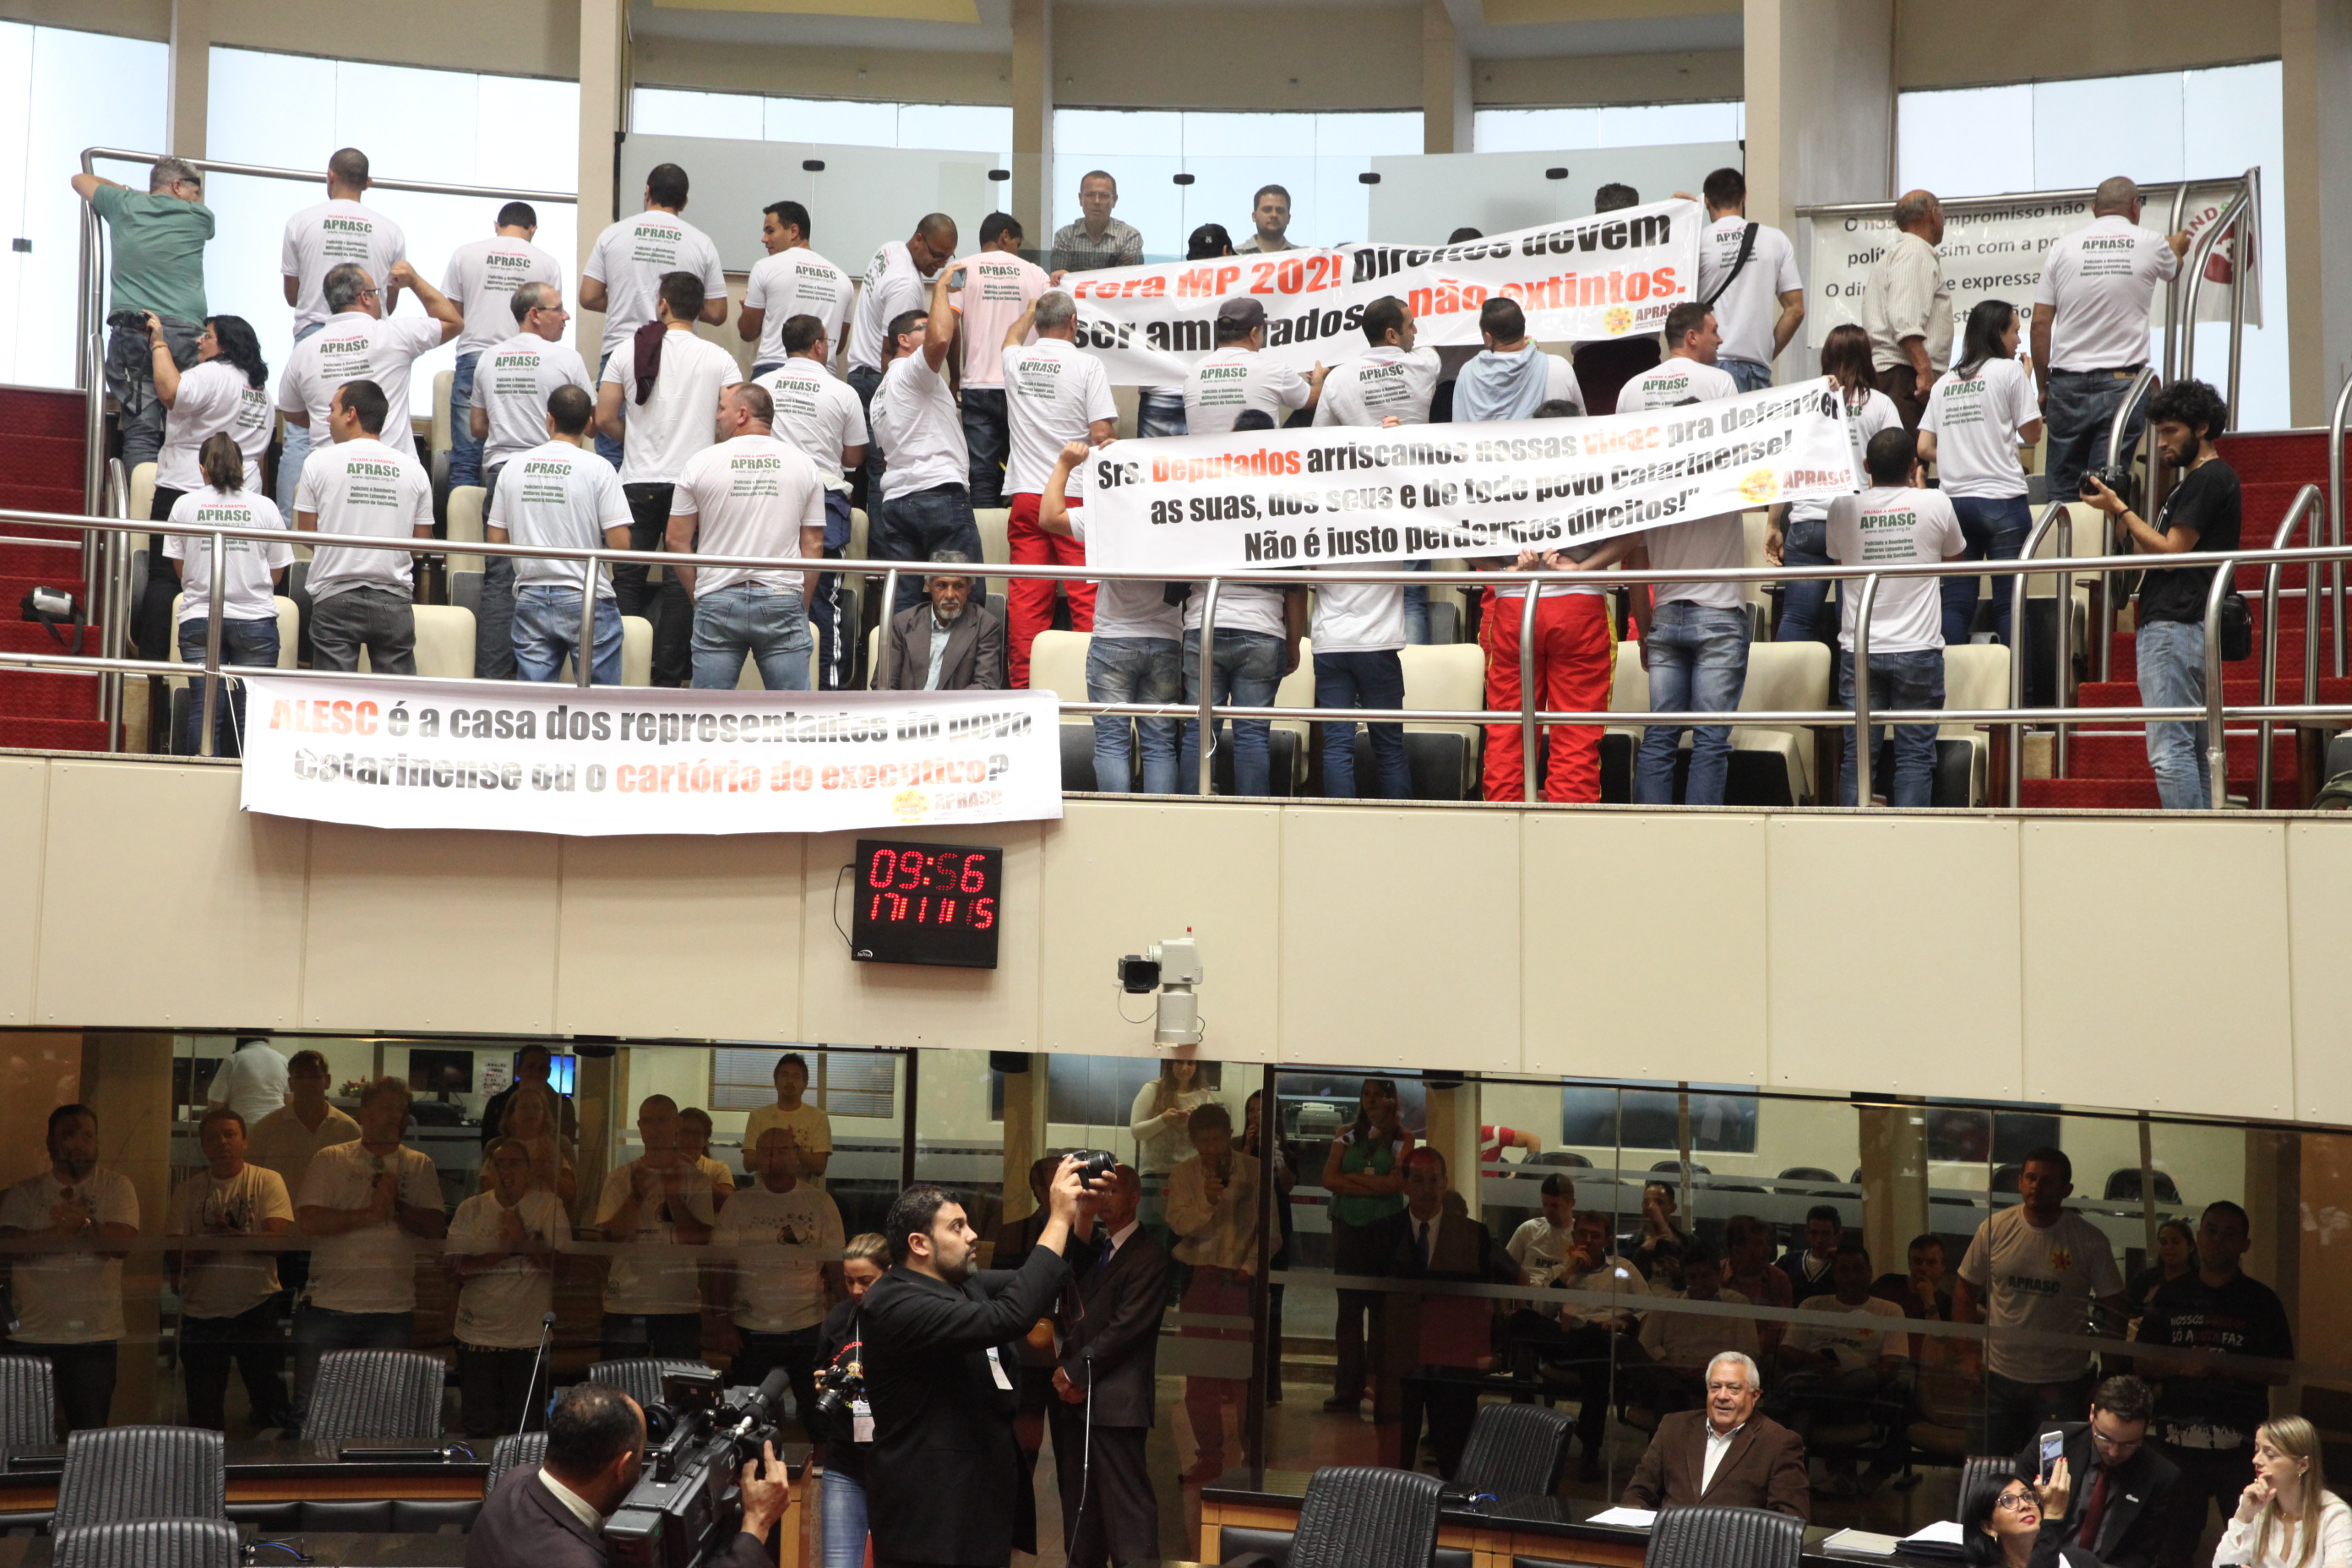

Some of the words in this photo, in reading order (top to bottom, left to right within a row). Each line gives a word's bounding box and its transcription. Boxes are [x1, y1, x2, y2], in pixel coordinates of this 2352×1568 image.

[1864, 219, 1896, 231] nos
[1943, 205, 2045, 227] mpromisso
[2050, 201, 2085, 216] não
[323, 219, 373, 233] APRASC
[634, 227, 682, 241] APRASC
[1977, 237, 2014, 255] com
[2021, 238, 2031, 250] a
[2082, 238, 2135, 250] APRASC
[486, 255, 531, 268] APRASC
[1074, 275, 1167, 299] Fora
[1177, 265, 1241, 297] MP
[1250, 254, 1343, 295] 202!
[1352, 241, 1512, 284] Direitos
[1522, 214, 1672, 256] devem
[795, 265, 837, 280] APRASC
[979, 265, 1021, 276] APRASC
[1825, 283, 1839, 297] O
[1845, 282, 1865, 296] dir
[1075, 320, 1136, 350] ser
[1146, 304, 1364, 351] amados
[1407, 279, 1488, 318] não
[1499, 266, 1686, 311] extintos.
[1636, 302, 1684, 321] APRAS
[319, 339, 369, 353] APRASC
[494, 356, 540, 368] APRASC
[1019, 361, 1061, 373] APRASC
[1200, 367, 1247, 379] APRASC
[1359, 364, 1404, 381] APRASC
[775, 379, 820, 393] APRASC
[1642, 377, 1689, 391] APRASC
[1942, 380, 1985, 397] APRASC
[1098, 460, 1146, 489] Srs.
[1152, 449, 1301, 483] Deputados
[1307, 441, 1468, 472] arriscamos
[1475, 435, 1576, 462] nossas
[1668, 417, 1713, 448] pra
[1721, 389, 1839, 433] defender
[346, 463, 400, 477] APRASC
[523, 462, 572, 476] APRASC
[730, 458, 781, 469] APRASC
[1151, 498, 1183, 524] as
[1190, 494, 1261, 521] suas,
[1268, 490, 1319, 515] dos
[1326, 487, 1393, 512] seus
[1400, 483, 1416, 508] e
[1423, 478, 1457, 507] de
[1464, 475, 1528, 504] todo
[1536, 470, 1603, 502] povo
[1610, 429, 1793, 487] Catarinense!
[1783, 469, 1851, 489] APRASC
[197, 509, 252, 521] APRASC
[1859, 512, 1916, 530] APRASC
[1244, 530, 1296, 562] Não
[1304, 527, 1320, 558] é
[1326, 524, 1398, 559] justo
[1405, 514, 1562, 554] perdermos
[270, 700, 378, 736] ALESC
[387, 700, 410, 737] é
[419, 708, 439, 738] a
[449, 708, 536, 739] casa
[546, 705, 611, 741] dos
[620, 711, 889, 745] representantes
[896, 710, 939, 742] do
[949, 711, 1032, 743] povo
[531, 763, 575, 792] ou
[585, 764, 607, 792] o
[616, 758, 761, 793] cartório
[770, 760, 813, 792] do
[821, 753, 1009, 791] executivo?
[868, 848, 986, 893] 09:56
[2008, 1276, 2060, 1293] APRASC
[2170, 1314, 2204, 1326] NOSSOS
[2221, 1331, 2245, 1347] FAZ
